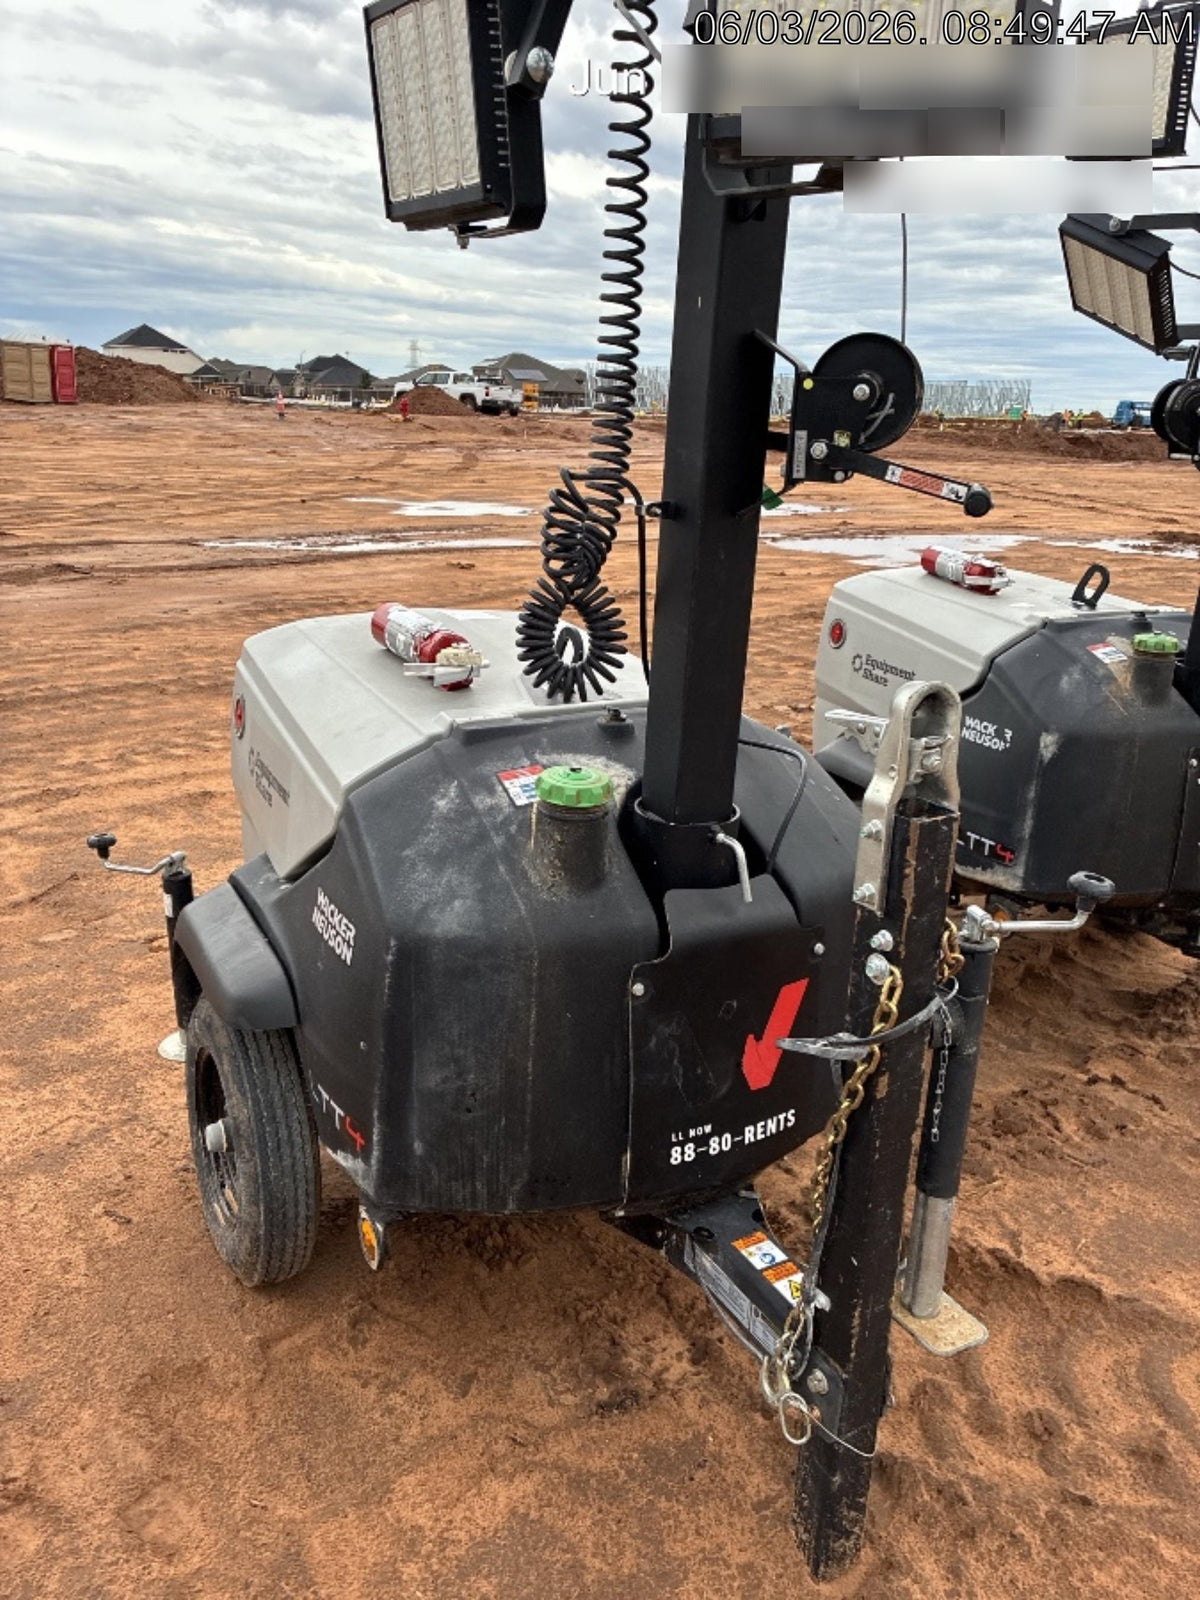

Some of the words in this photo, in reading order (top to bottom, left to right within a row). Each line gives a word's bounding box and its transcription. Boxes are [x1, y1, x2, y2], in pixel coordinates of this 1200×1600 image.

[311, 905, 353, 967] NEUSON
[317, 886, 356, 947] WACKER
[688, 1122, 713, 1139] NOW
